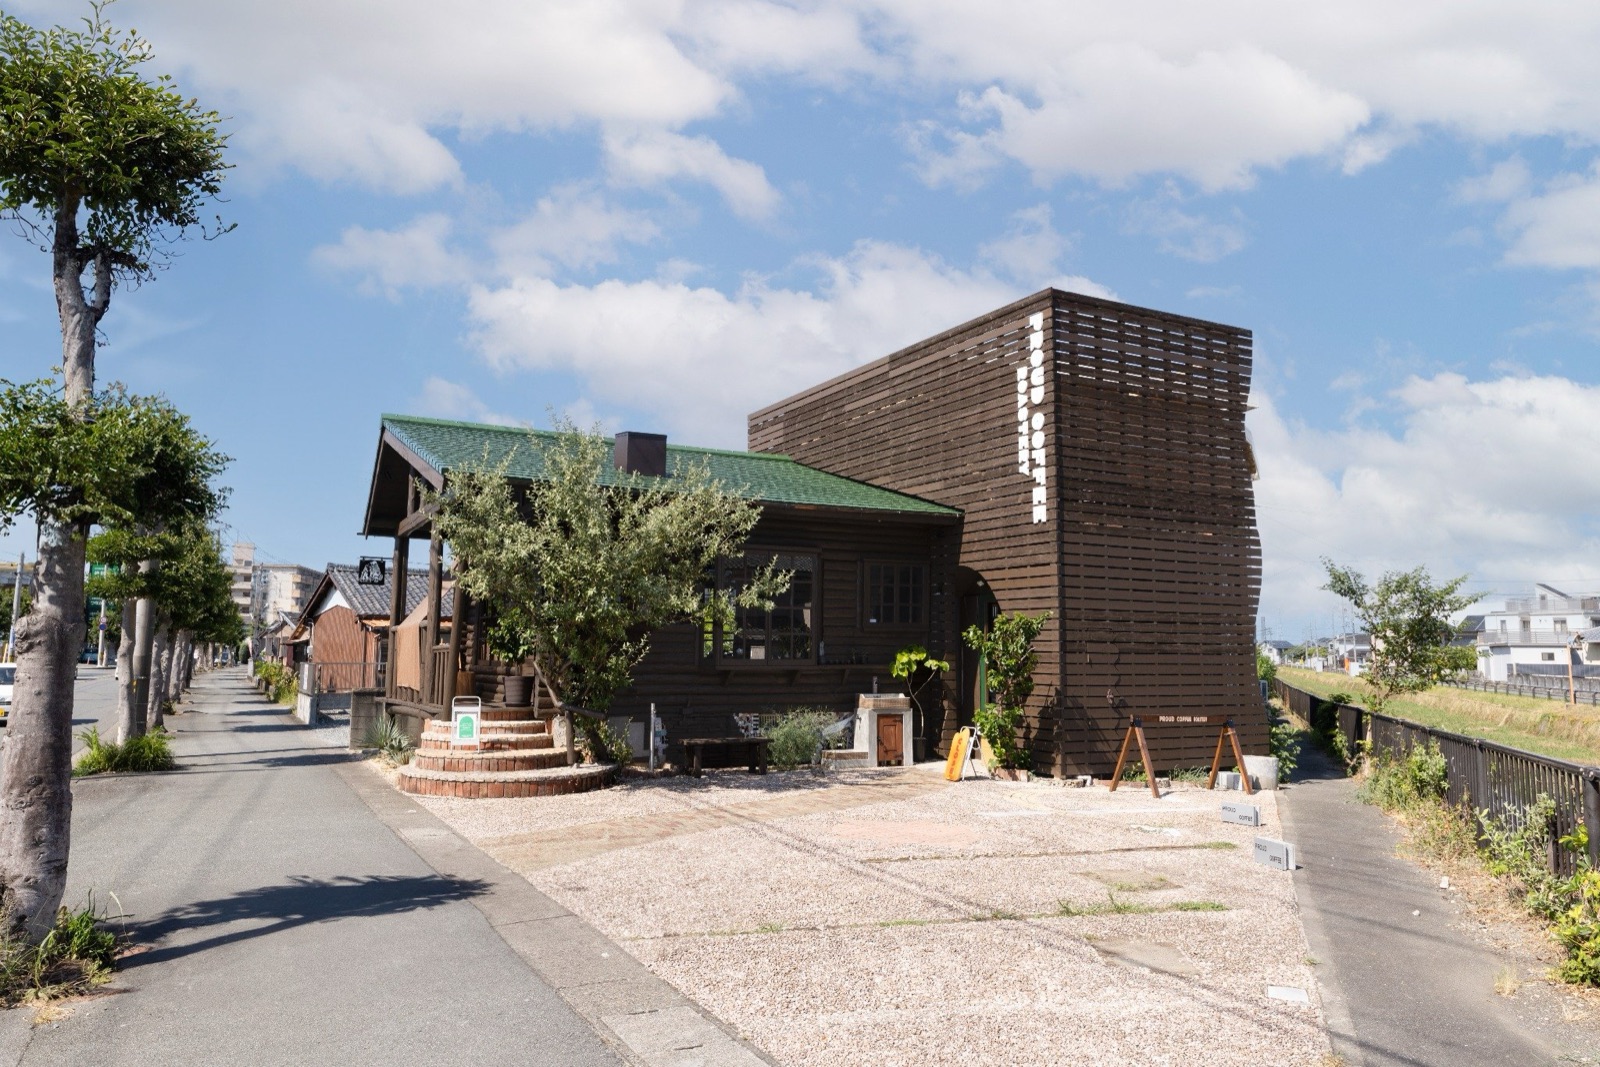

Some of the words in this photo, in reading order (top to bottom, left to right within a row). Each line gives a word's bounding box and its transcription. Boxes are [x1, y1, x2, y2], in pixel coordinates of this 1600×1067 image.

[1029, 312, 1045, 405] PROUD
[1017, 366, 1030, 476] ROASTERY
[1031, 412, 1047, 524] COFFEE
